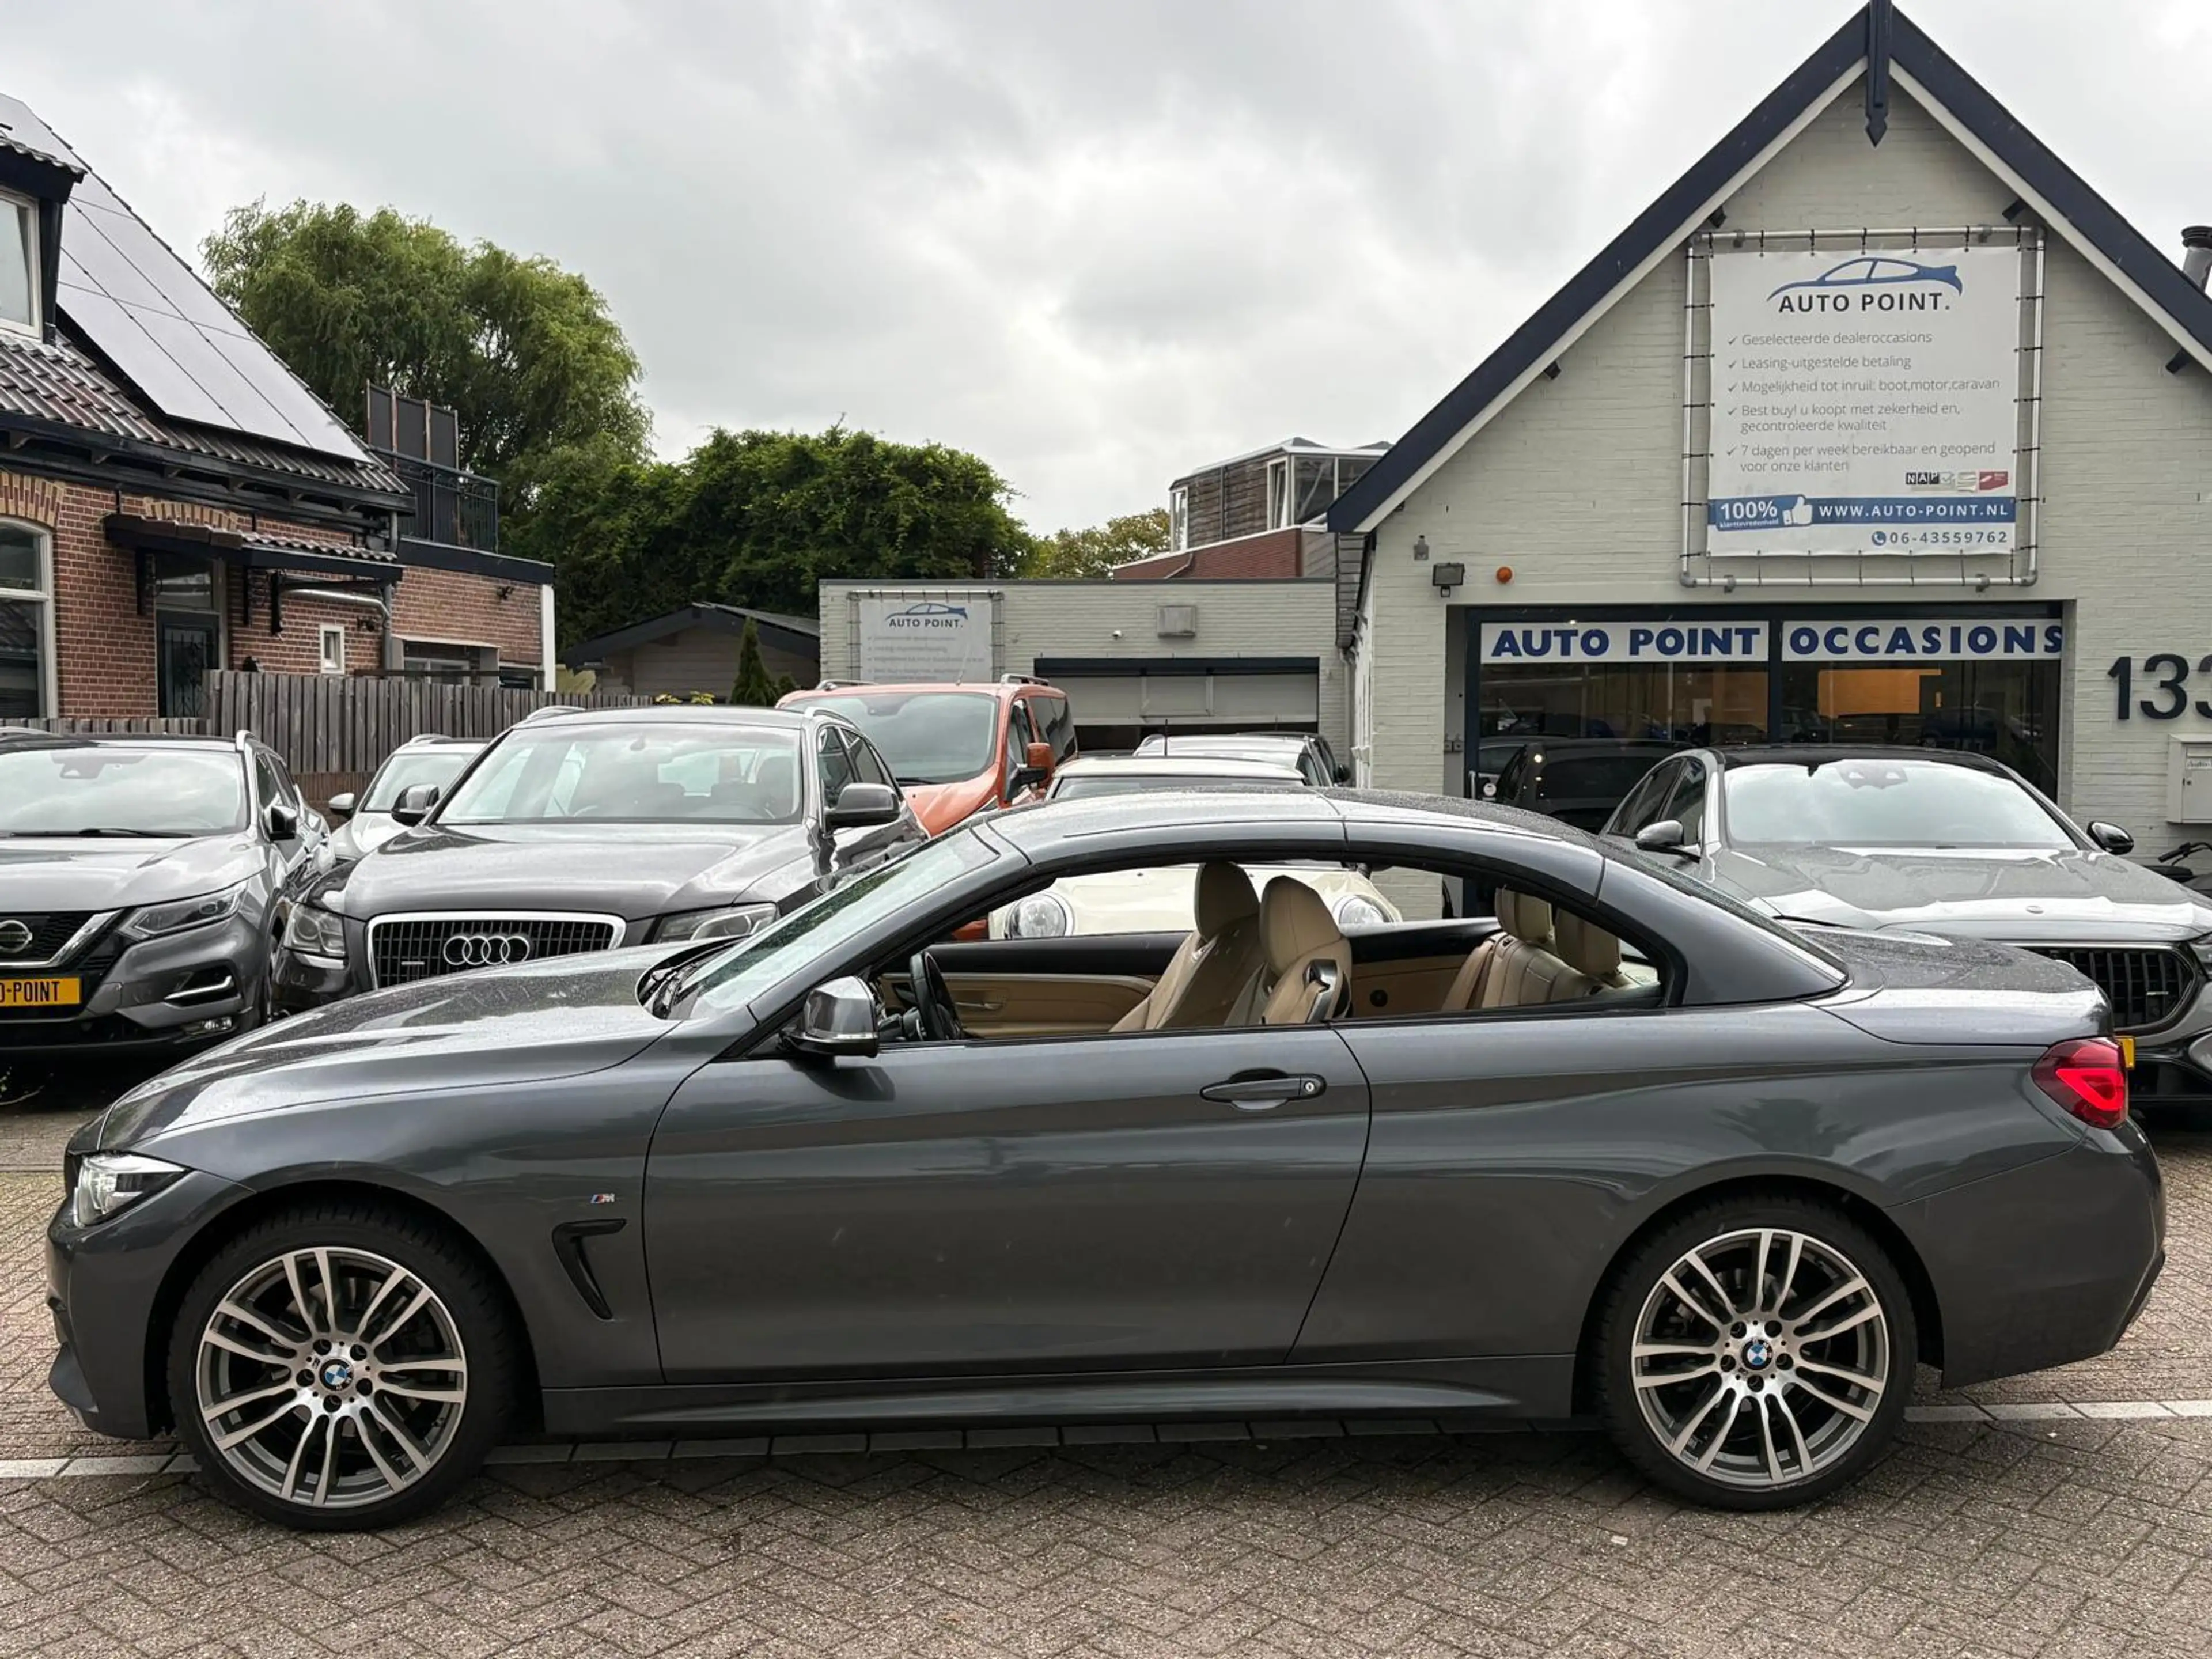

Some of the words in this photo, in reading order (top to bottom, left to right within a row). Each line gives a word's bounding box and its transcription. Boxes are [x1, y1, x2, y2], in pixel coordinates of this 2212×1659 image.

[1778, 294, 1850, 313] AUTO
[1861, 292, 1950, 312] POINT.
[1741, 334, 1830, 346] Geselecteerde
[1833, 331, 1933, 344] dealeroccasions
[1741, 356, 1859, 372] Leasing-uitgestelde
[1862, 355, 1911, 370] betaling
[1741, 380, 1818, 395] Mogelijkheid
[1821, 380, 1838, 391] tot
[1878, 378, 2001, 393] boot,motor,caravan
[1741, 404, 1769, 416] Best
[1800, 407, 1808, 415] u
[1812, 404, 1847, 418] koopt
[1850, 405, 1874, 415] met
[1878, 402, 1938, 415] zekerheid
[1740, 420, 1834, 435] gecontroleerde
[1741, 444, 1749, 456] 7
[1751, 444, 1789, 460] dagen
[1793, 445, 1814, 459] per
[1817, 442, 1849, 455] week
[1852, 442, 1918, 455] bereikbaar
[1921, 446, 1937, 454] en
[1940, 441, 1996, 457] geopend
[1740, 461, 1768, 472] voor
[1771, 461, 1801, 472] onze
[1804, 459, 1849, 471] klanten
[1905, 472, 1940, 485] NAP
[1720, 499, 1778, 520] 100%
[1819, 504, 2009, 517] WWW.AUTO-POINT.NL
[1889, 531, 2008, 544] 06-43559762
[889, 618, 921, 628] AUTO
[925, 618, 964, 628] POINT.
[1491, 628, 1610, 657] AUTO
[1628, 627, 1760, 656] POINT
[1789, 624, 2062, 656] OCCASIONS
